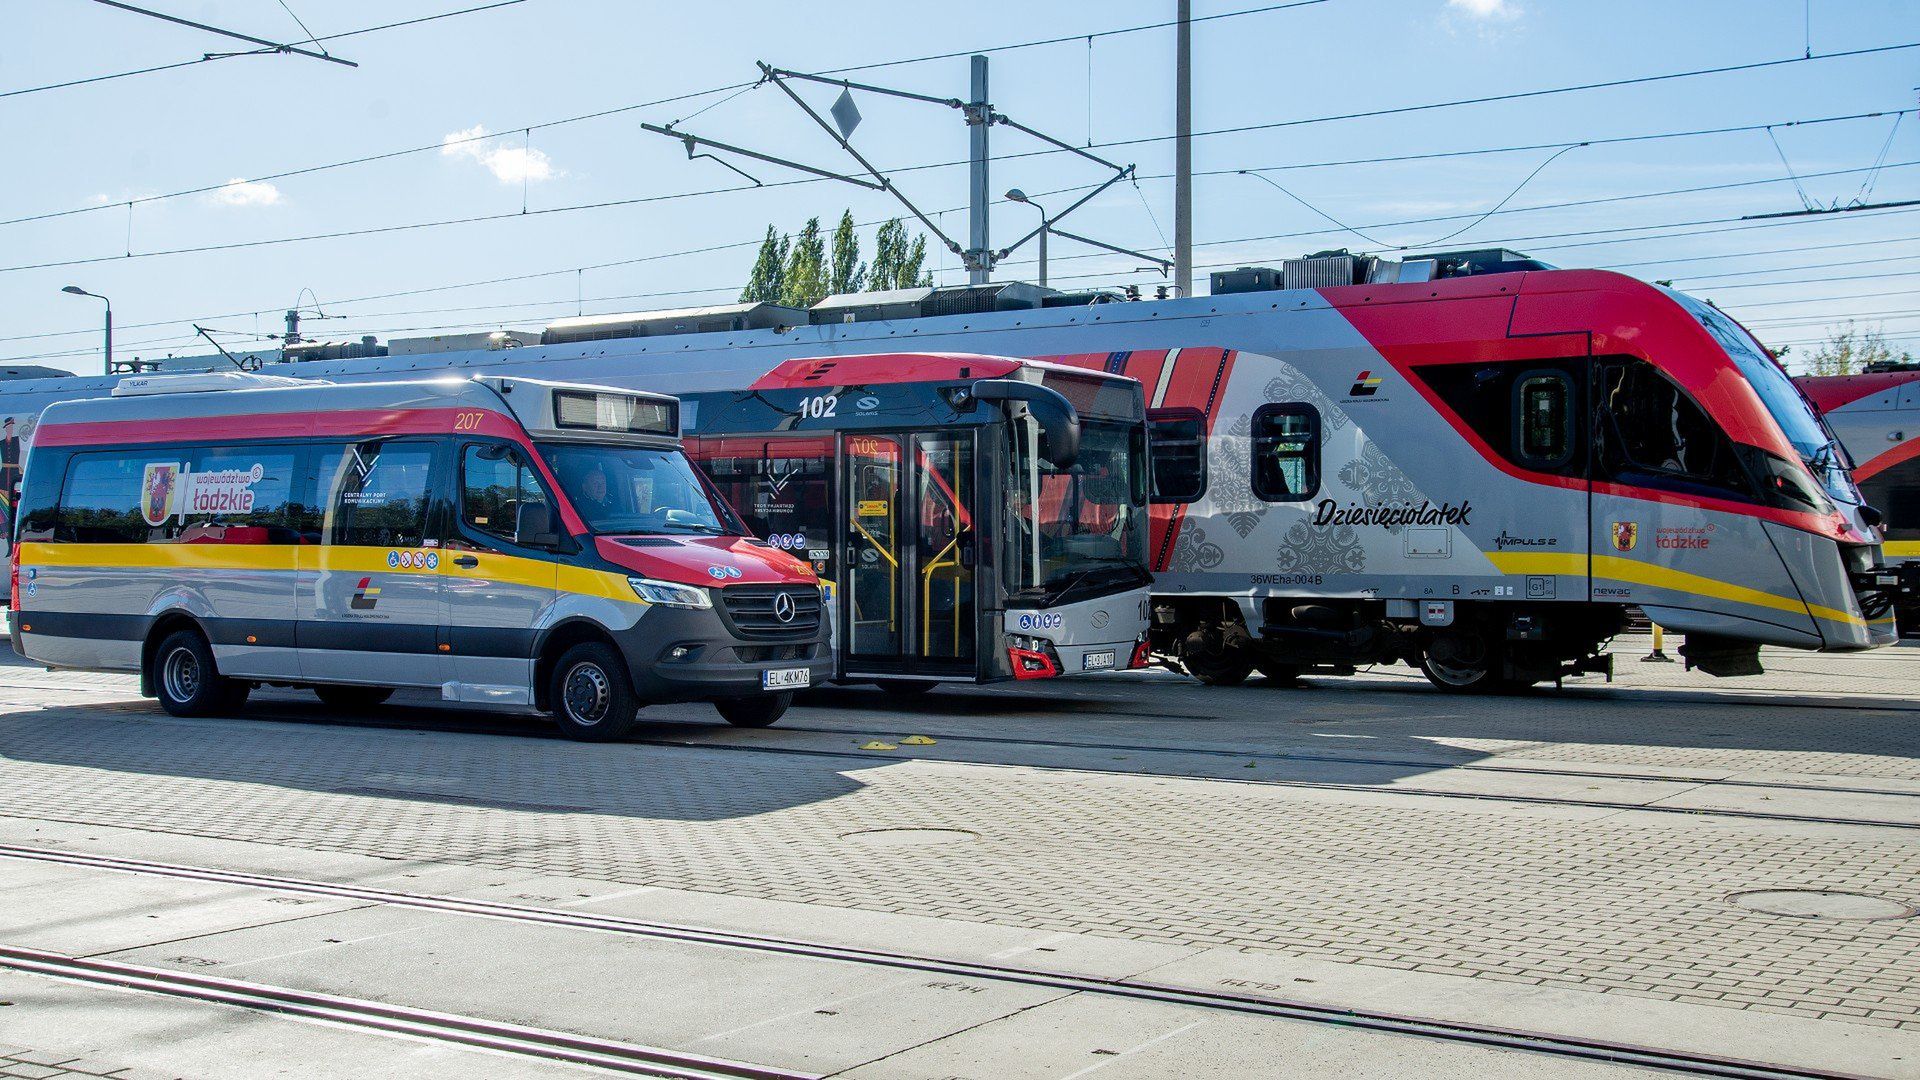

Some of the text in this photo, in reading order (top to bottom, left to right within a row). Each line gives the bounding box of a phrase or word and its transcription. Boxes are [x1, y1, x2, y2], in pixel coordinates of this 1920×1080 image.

[799, 395, 838, 419] 102
[454, 412, 484, 430] 207
[196, 473, 251, 485] województwo
[193, 487, 253, 511] łódzkie
[1313, 498, 1473, 529] Dziesięciolatek
[1547, 538, 1557, 546] 2
[1250, 574, 1323, 585] 36WEha-004 B
[1178, 584, 1187, 592] 7A
[1423, 587, 1434, 595] 8A
[1452, 585, 1460, 594] B
[1531, 583, 1542, 591] G1
[769, 672, 781, 685] EL
